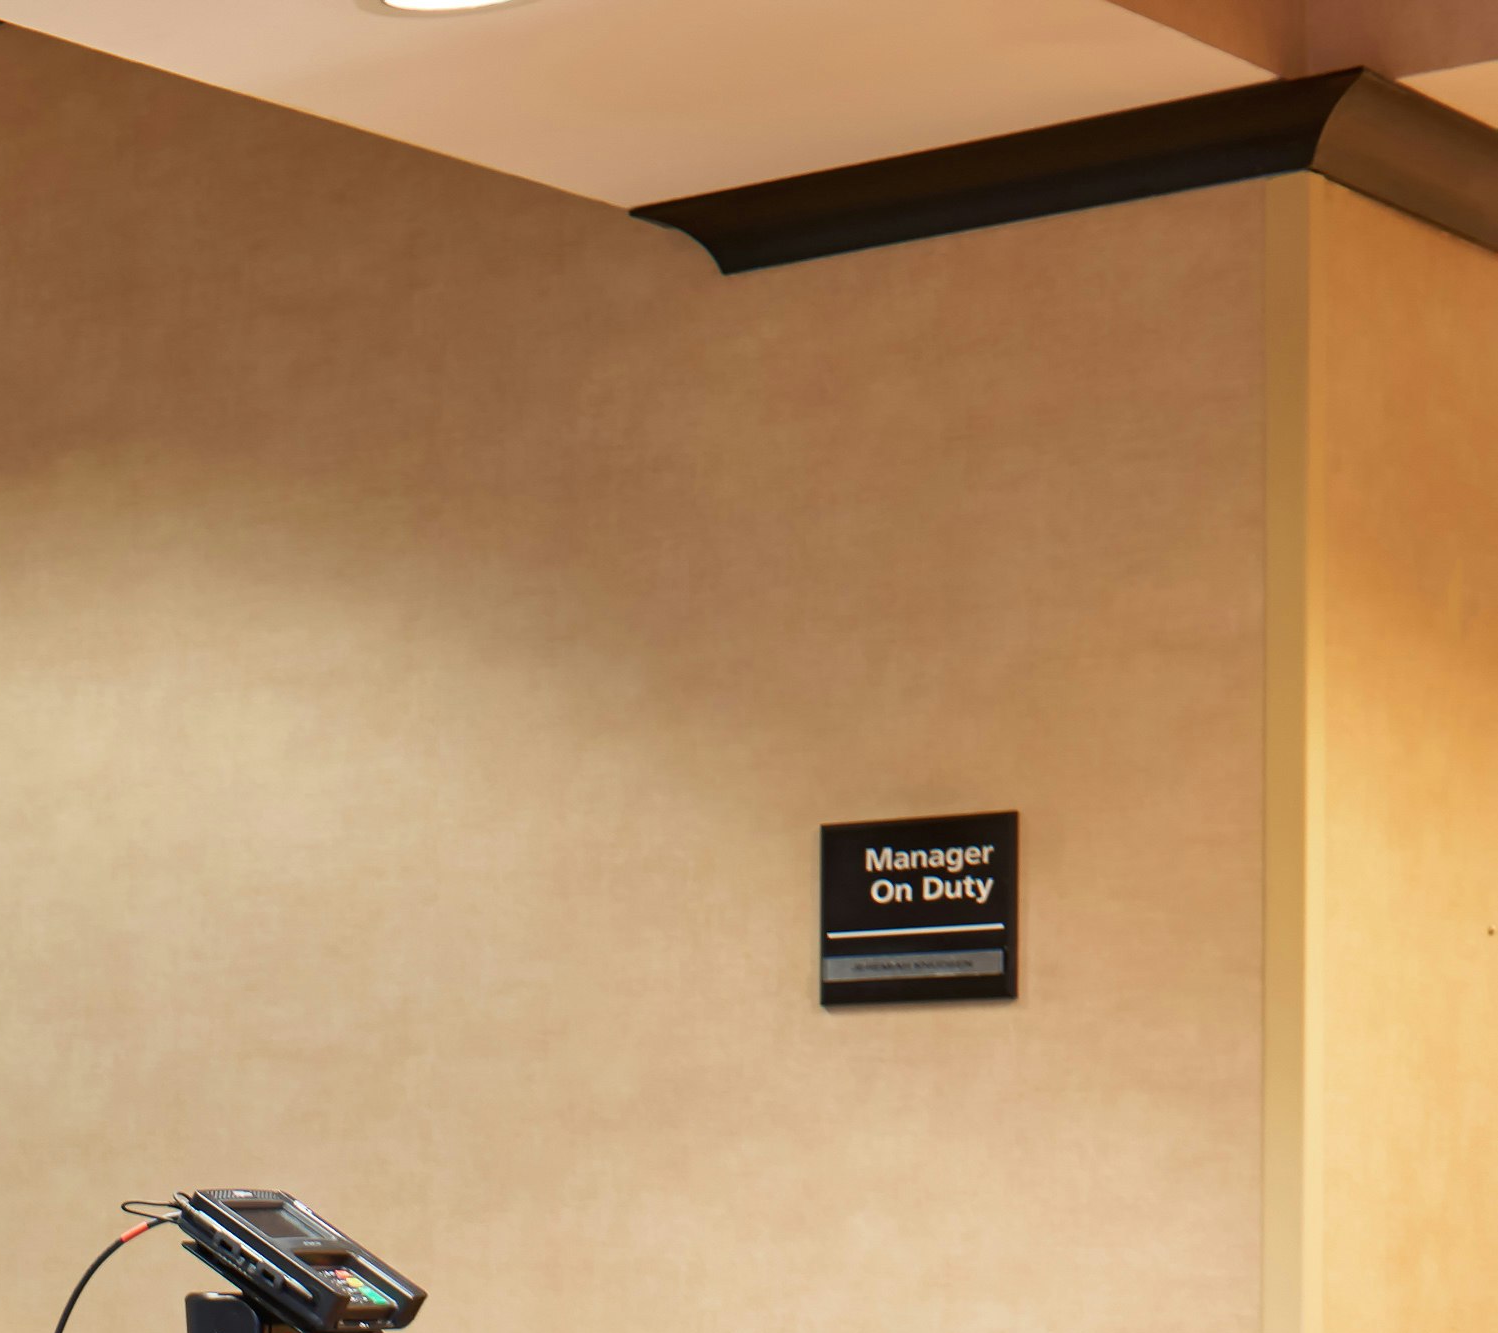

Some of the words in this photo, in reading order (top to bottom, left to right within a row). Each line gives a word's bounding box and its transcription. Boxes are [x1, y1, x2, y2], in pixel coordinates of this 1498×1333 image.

[865, 845, 994, 873] Manager
[870, 879, 913, 904] On
[922, 875, 994, 904] Duty
